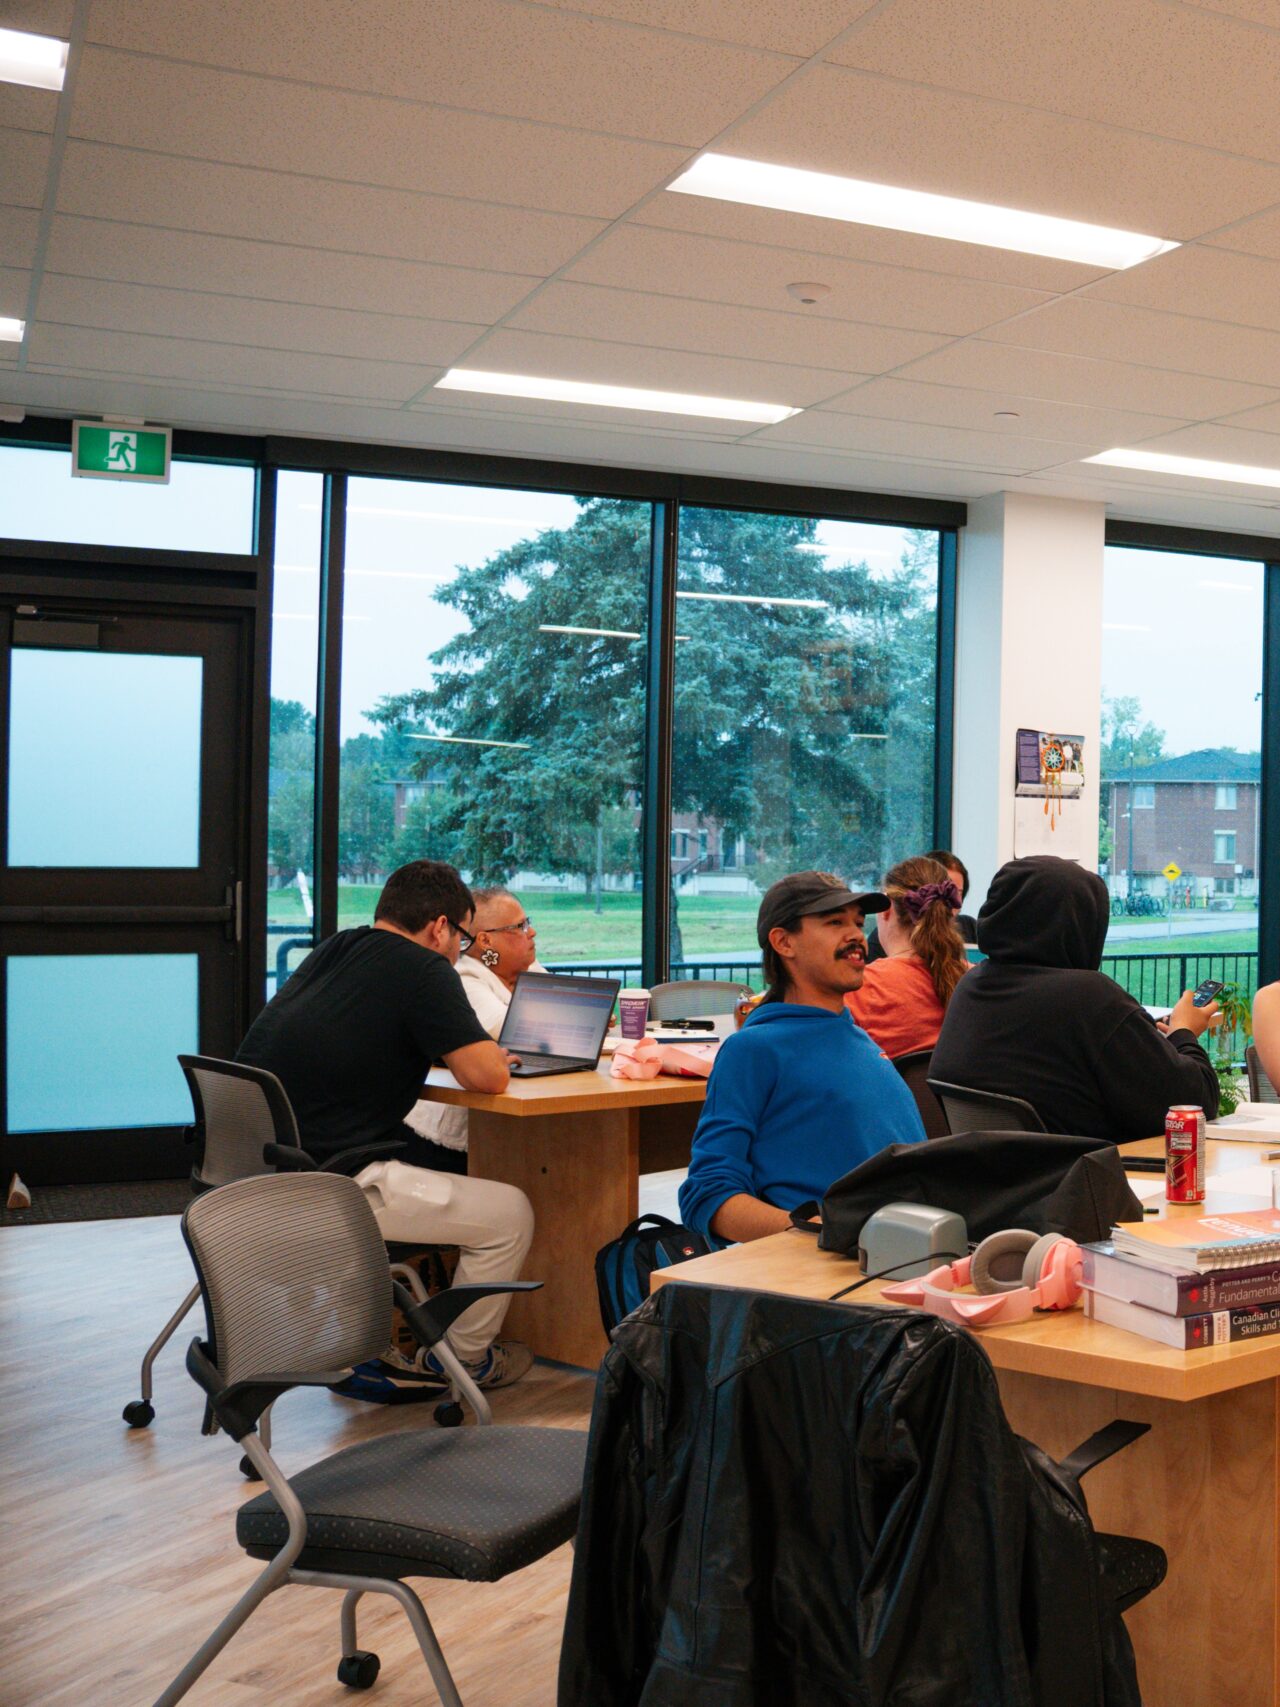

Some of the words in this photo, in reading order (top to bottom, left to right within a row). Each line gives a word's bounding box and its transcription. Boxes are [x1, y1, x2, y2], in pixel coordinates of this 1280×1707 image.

[1232, 1311, 1269, 1325] Canadian
[1241, 1323, 1261, 1336] Skills
[1262, 1320, 1277, 1332] and
